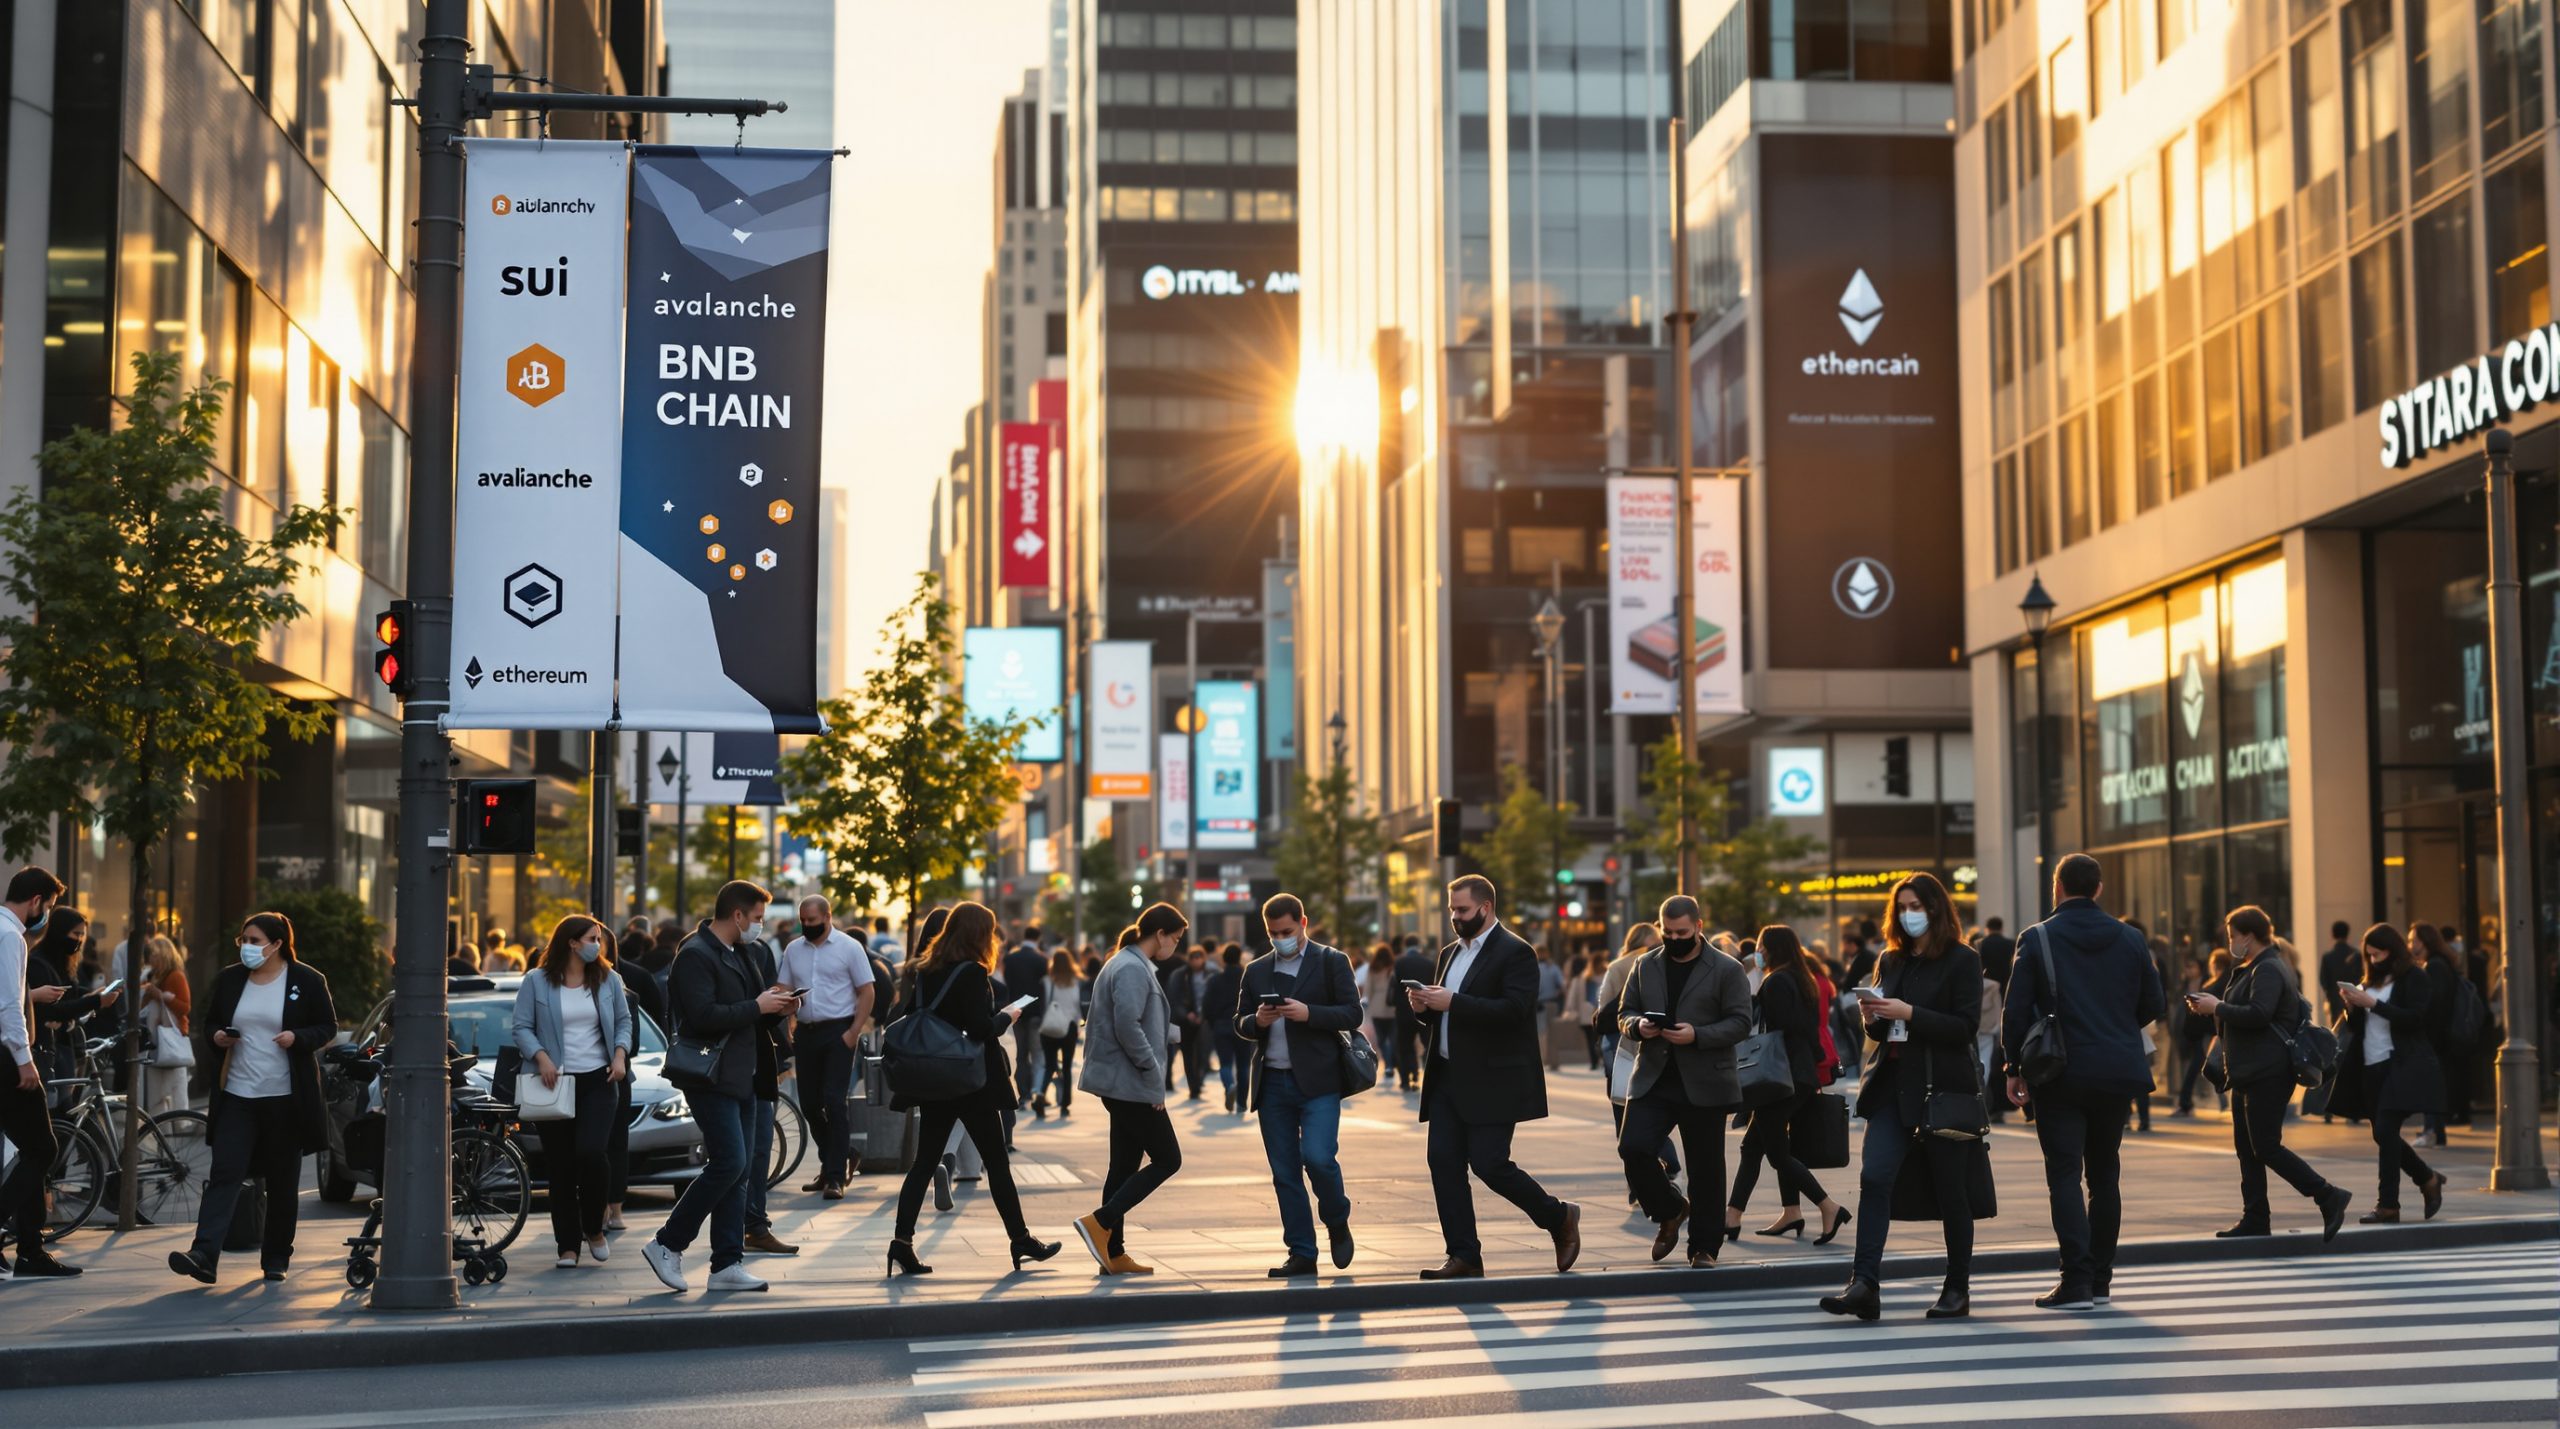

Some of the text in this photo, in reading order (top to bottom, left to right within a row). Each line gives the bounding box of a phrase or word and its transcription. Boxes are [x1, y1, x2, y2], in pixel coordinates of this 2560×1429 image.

[500, 256, 568, 297] sui
[654, 292, 796, 318] avalanche
[659, 344, 757, 381] BNB
[656, 391, 791, 429] CHAIN
[2380, 355, 2498, 468] SYTARA
[477, 467, 593, 488] avalianche
[492, 665, 588, 684] ethereum
